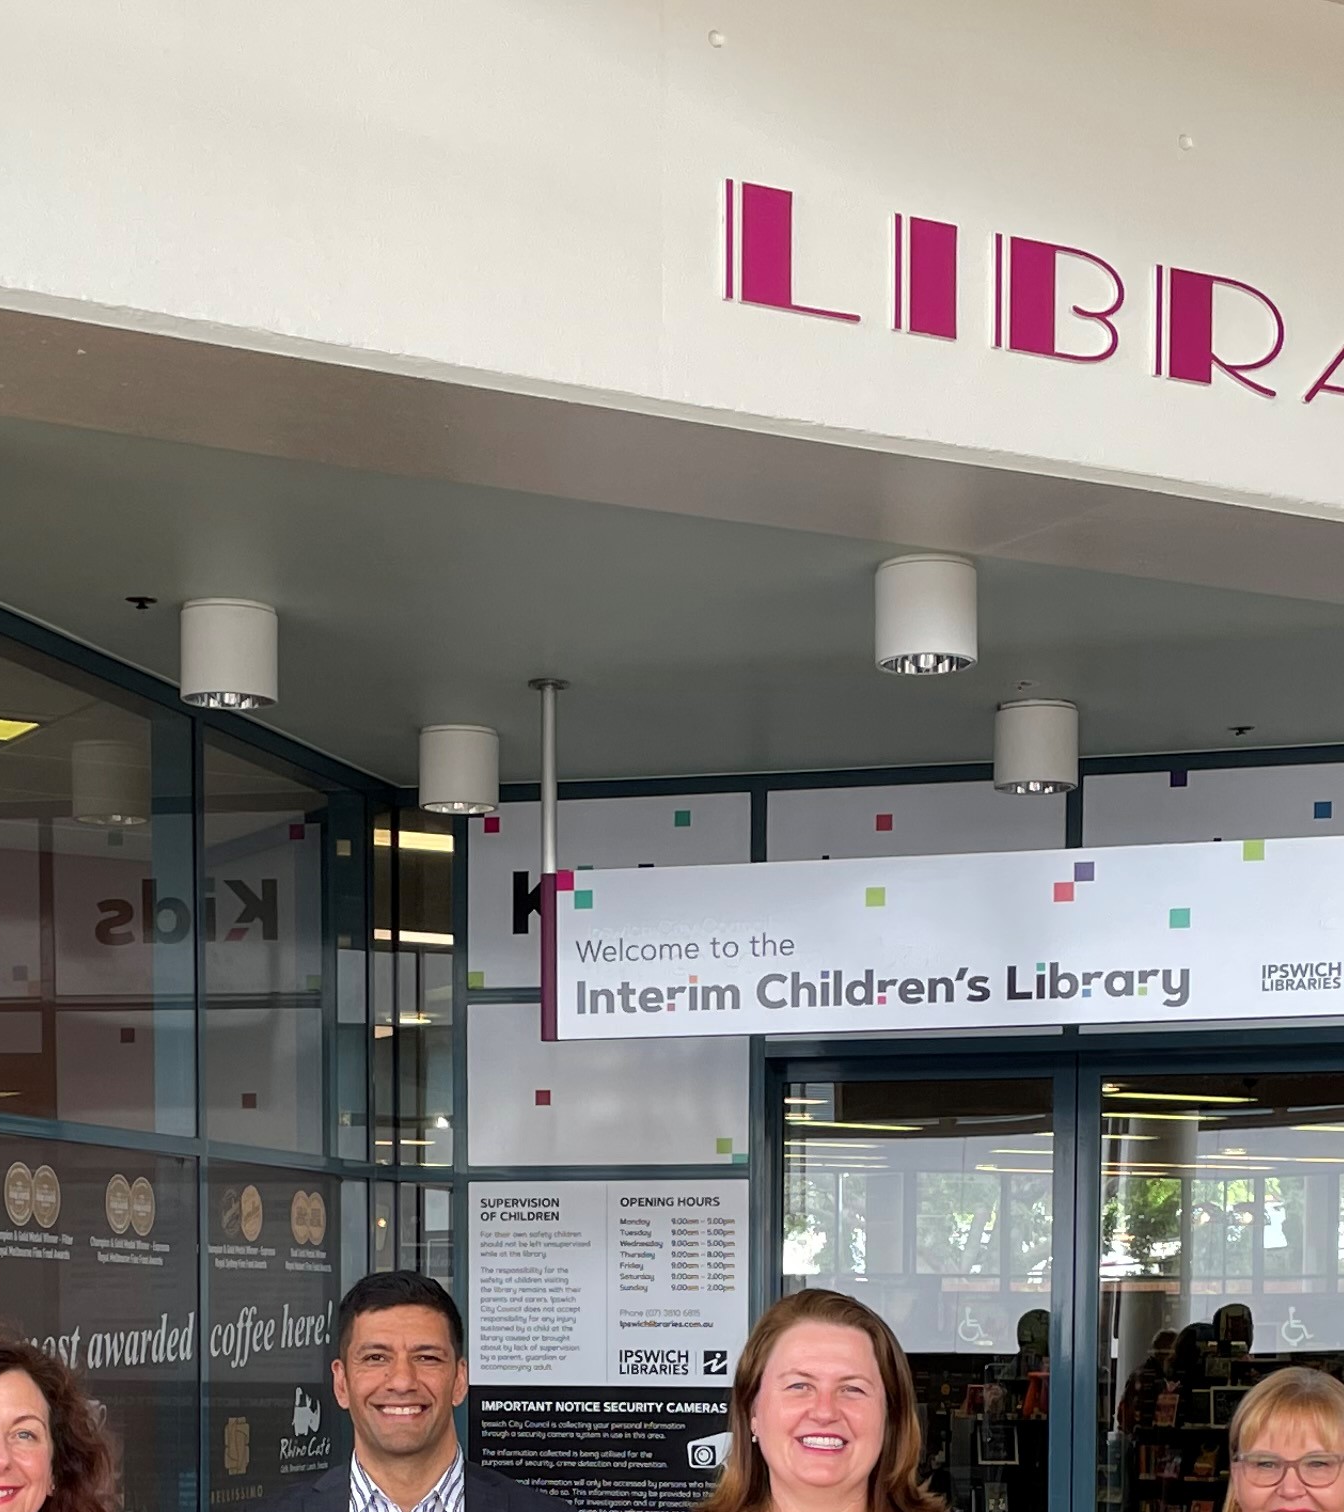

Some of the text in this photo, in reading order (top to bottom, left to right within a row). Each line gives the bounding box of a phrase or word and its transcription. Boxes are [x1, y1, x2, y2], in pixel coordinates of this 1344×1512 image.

[575, 932, 795, 963] Welcome to the
[1262, 961, 1341, 979] IPSWICH
[576, 962, 1190, 1014] Interim Children's Library
[1262, 977, 1341, 992] LIBRARIES
[481, 1198, 559, 1208] SUPERVISION
[620, 1197, 720, 1207] OPENING HOURS
[481, 1212, 559, 1221] OF CHILDREN
[620, 1218, 650, 1227] Monday
[620, 1229, 652, 1238] Tuesday
[620, 1240, 663, 1248] Wednesday
[620, 1251, 655, 1260] Thursday
[620, 1262, 643, 1271] Friday
[620, 1273, 655, 1281] Saturday
[620, 1284, 648, 1293] Sunday
[87, 1311, 195, 1369] awarded
[210, 1306, 275, 1368] coffee
[280, 1300, 333, 1349] here!
[619, 1350, 689, 1363] IPSWICH
[619, 1364, 689, 1375] LIBRARIES
[481, 1401, 727, 1413] IMPORTANT NOTICE SECURITY CAMERAS
